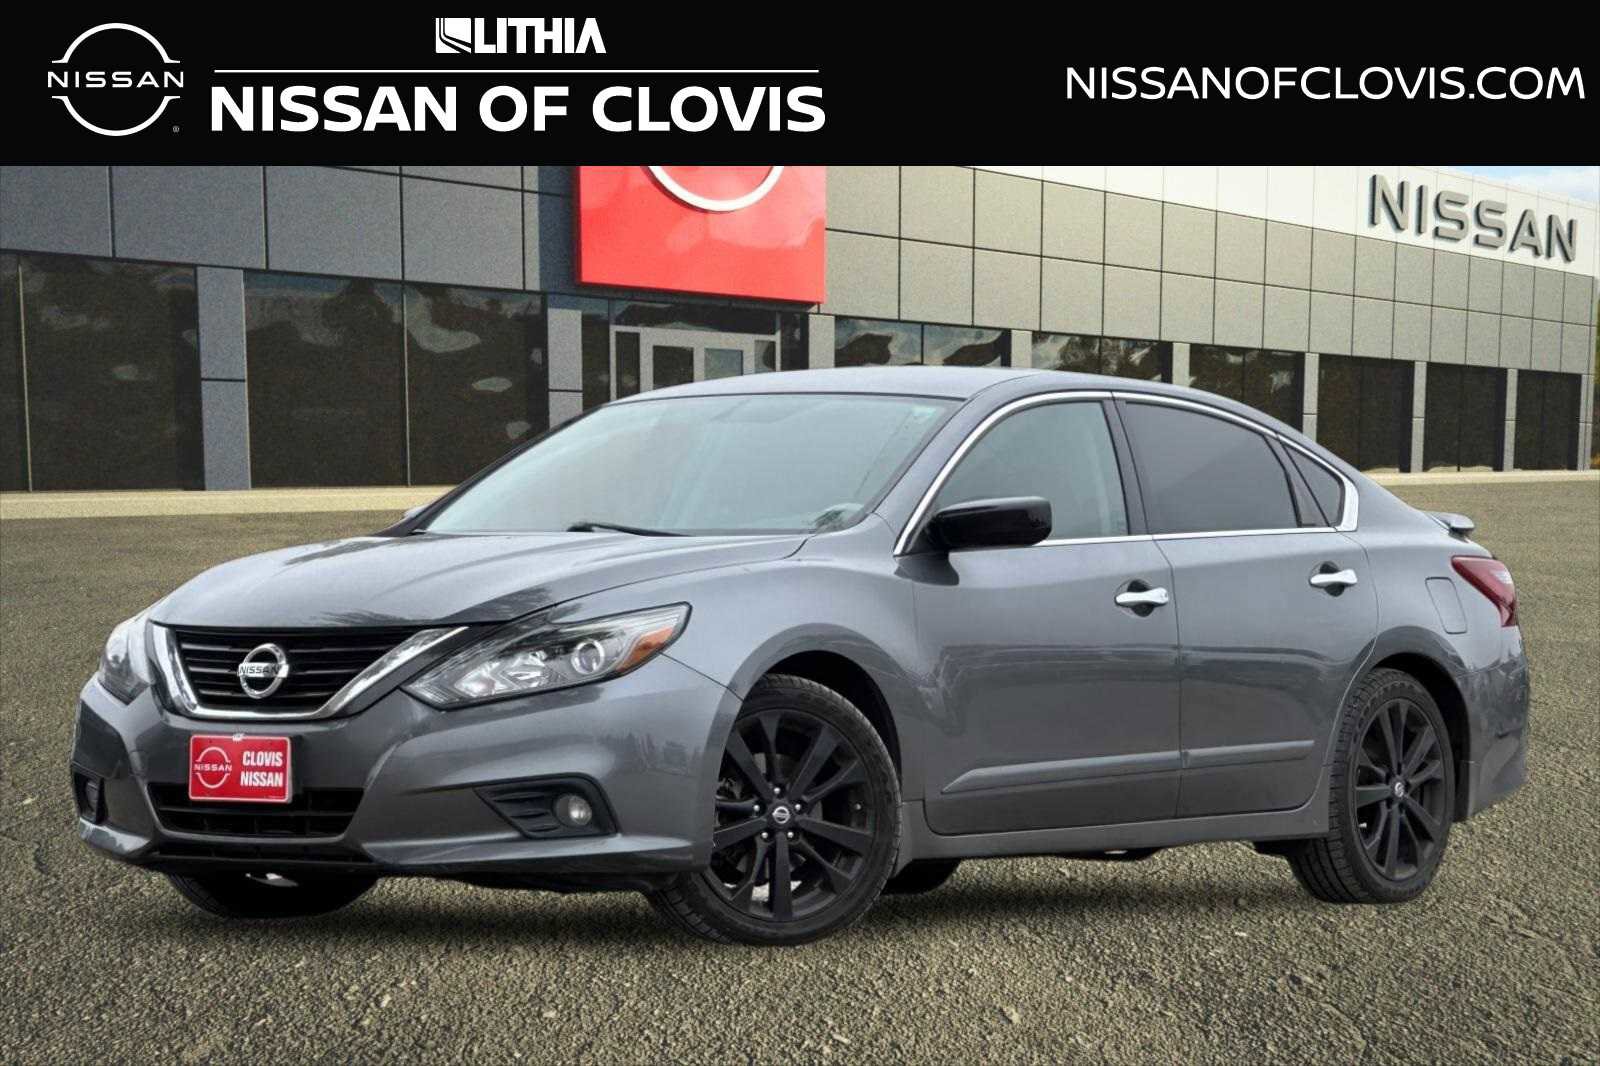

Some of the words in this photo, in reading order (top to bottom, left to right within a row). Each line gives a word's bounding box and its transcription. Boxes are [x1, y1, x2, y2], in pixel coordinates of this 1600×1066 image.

[1369, 174, 1578, 263] NISSAN
[239, 665, 281, 675] NISSAN
[242, 751, 283, 767] CLOVIS
[194, 763, 232, 772] NISSAN
[240, 771, 283, 787] NISSAN
